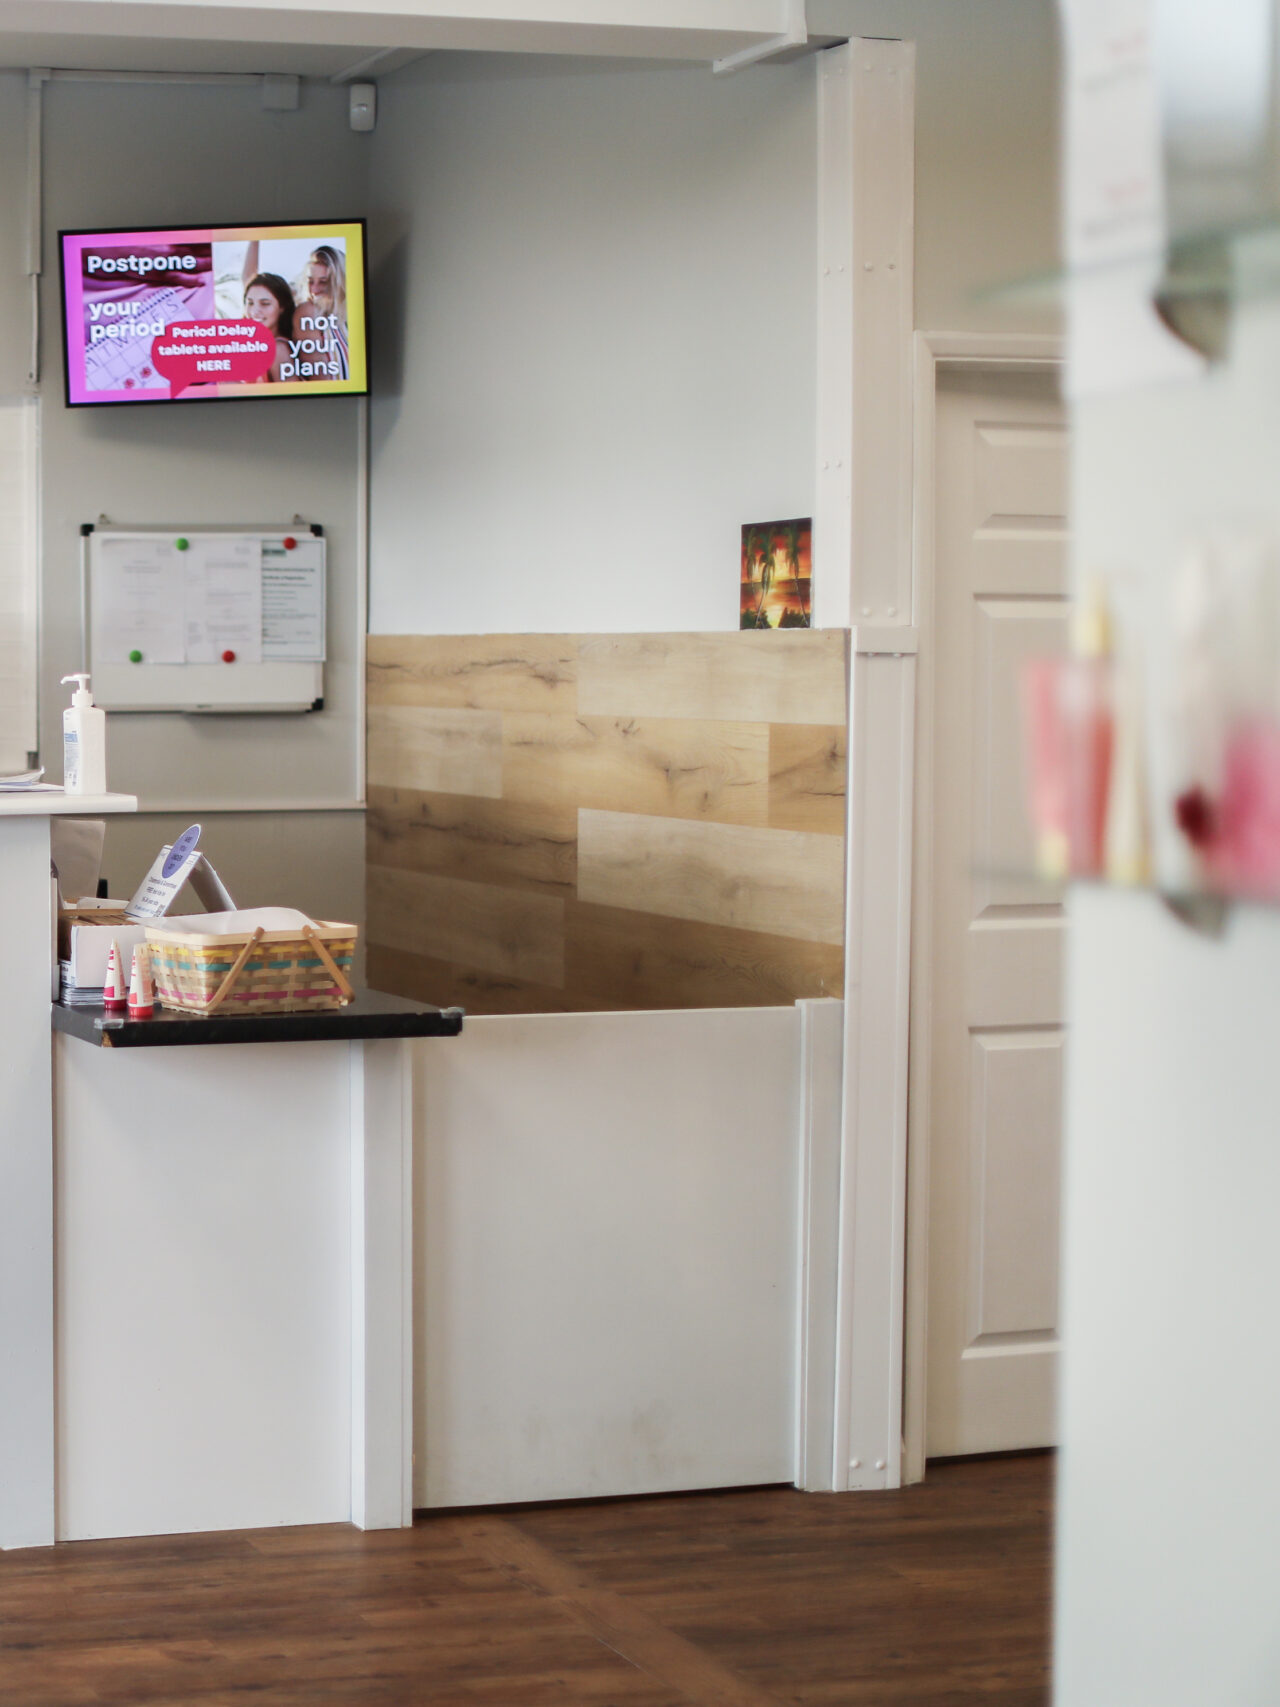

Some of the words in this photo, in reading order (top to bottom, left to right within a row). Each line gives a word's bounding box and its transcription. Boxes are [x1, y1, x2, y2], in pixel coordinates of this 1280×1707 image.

[87, 253, 196, 276] Postpone
[88, 301, 141, 321] your
[90, 318, 165, 343] period
[172, 325, 216, 338] Period
[217, 324, 256, 337] Delay
[300, 313, 338, 331] not
[158, 343, 206, 355] tablets
[208, 341, 268, 354] available
[288, 338, 338, 359] your
[196, 359, 231, 371] HERE
[280, 358, 339, 381] plans
